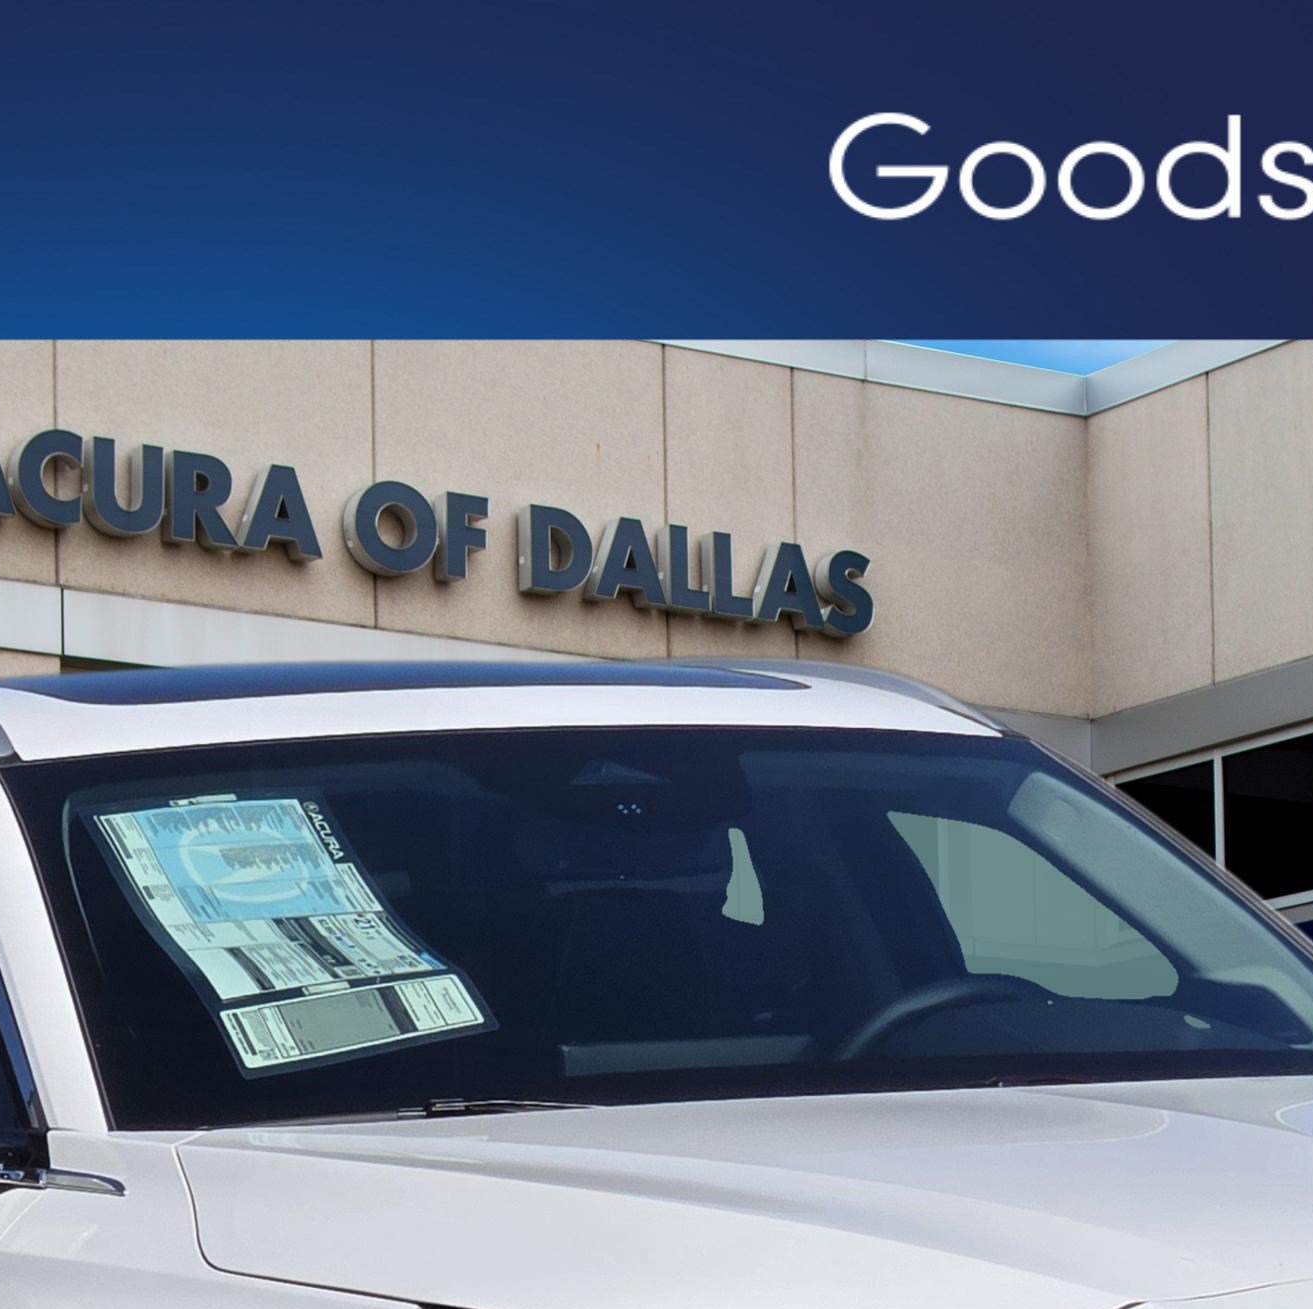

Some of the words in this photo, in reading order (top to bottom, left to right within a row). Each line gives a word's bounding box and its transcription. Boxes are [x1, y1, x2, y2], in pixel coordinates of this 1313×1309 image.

[343, 480, 489, 583] OF
[518, 503, 876, 638] DALLAS
[308, 812, 344, 860] ACURA
